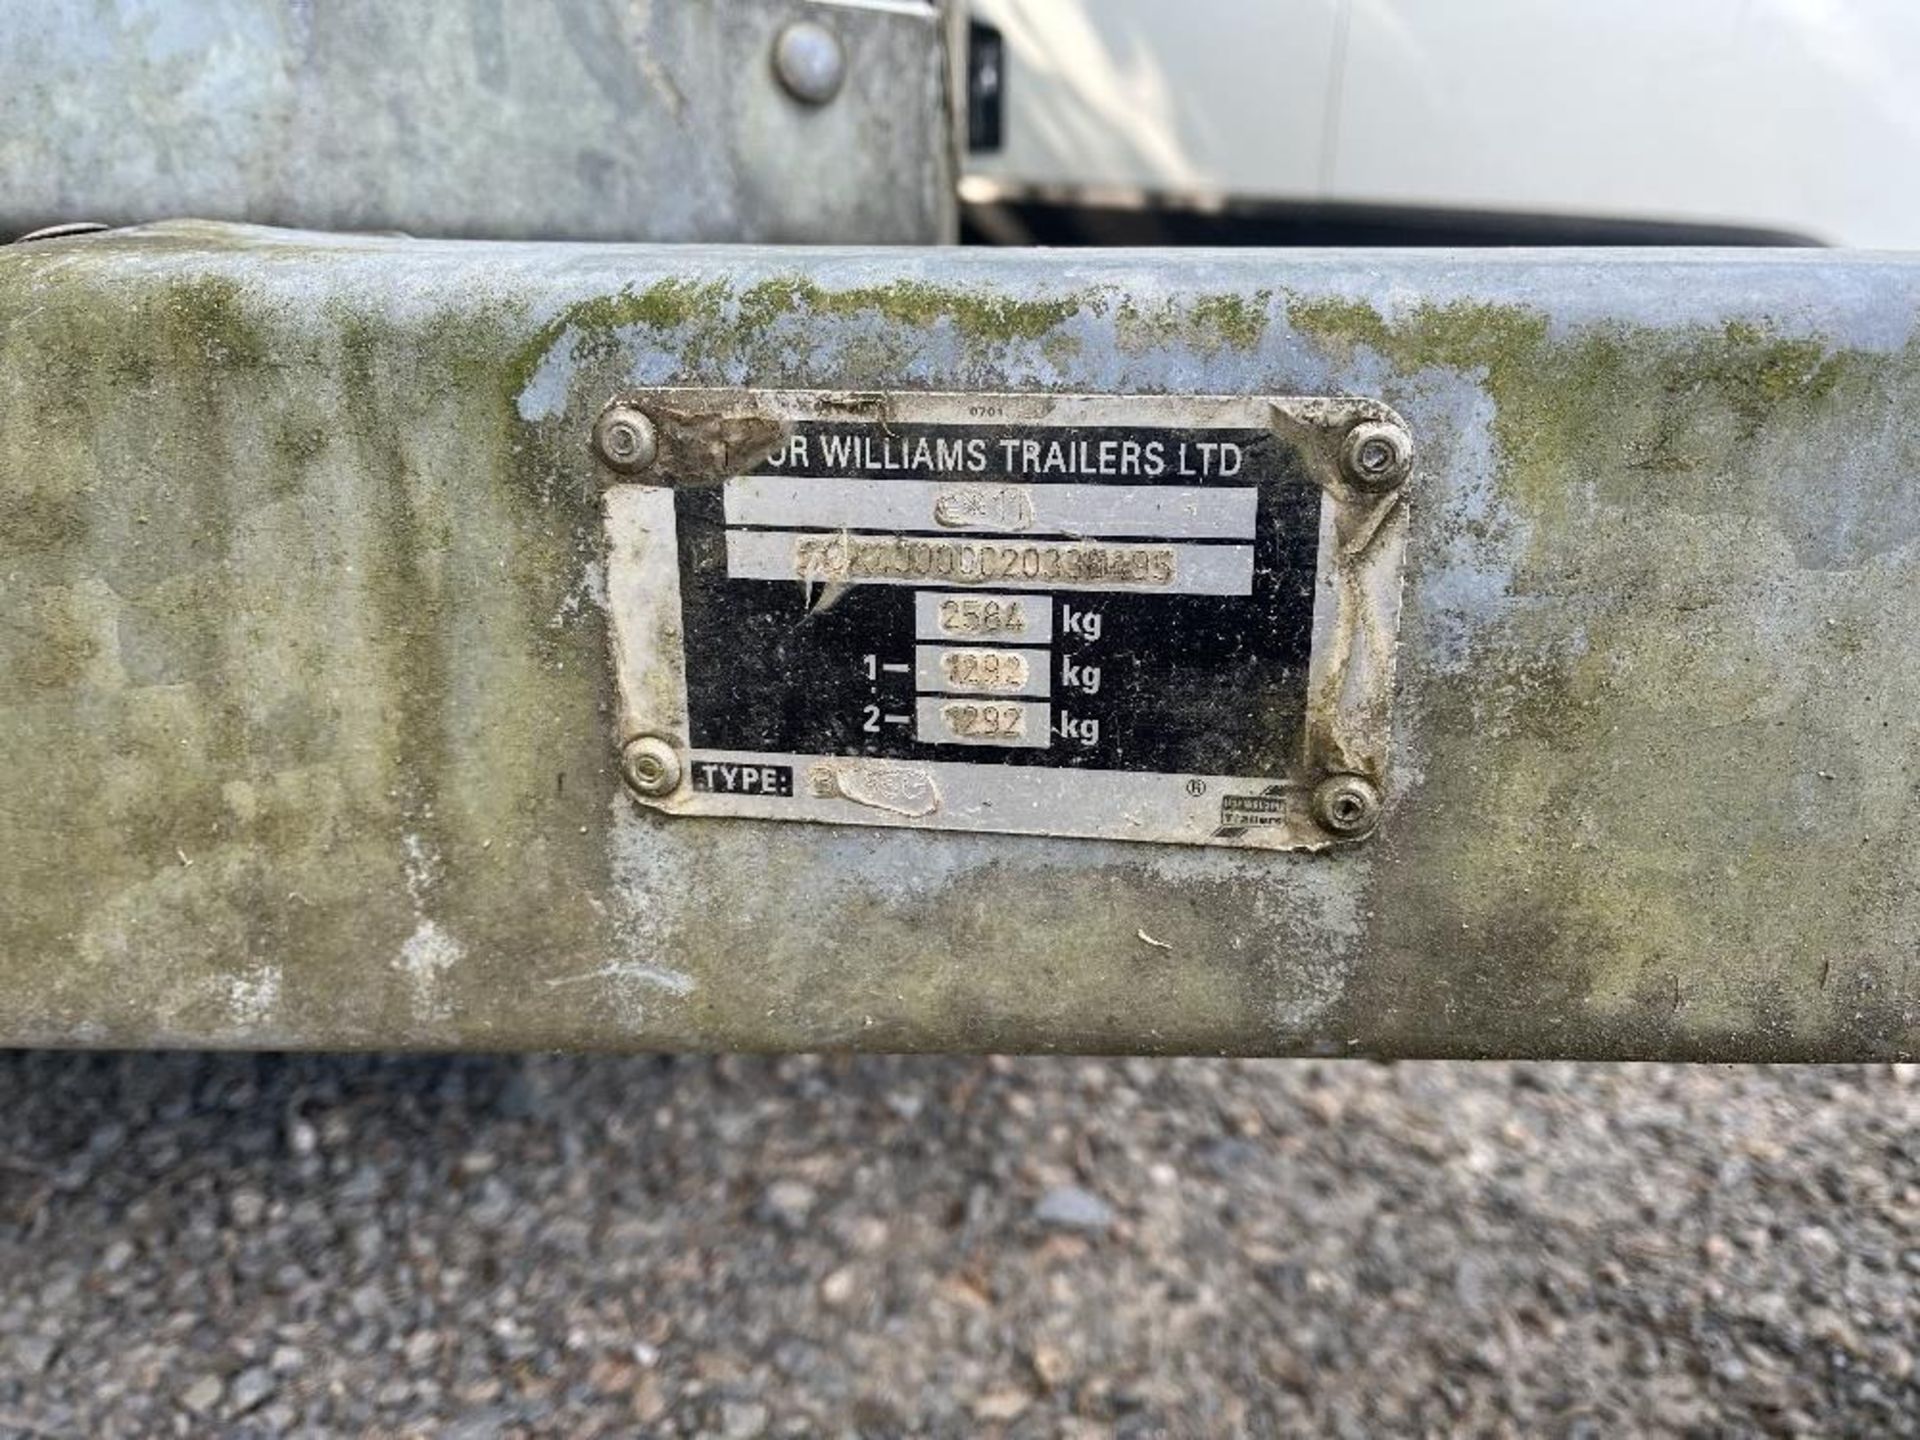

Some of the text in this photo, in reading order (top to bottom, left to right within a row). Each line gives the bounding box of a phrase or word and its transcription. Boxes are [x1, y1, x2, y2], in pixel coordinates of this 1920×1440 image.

[970, 406, 1003, 417] 0701
[821, 437, 988, 472] WILLIAMS
[1000, 440, 1166, 476] TRAILERS
[1179, 443, 1243, 477] LTD
[941, 599, 1102, 641] 2584 kg
[944, 653, 1022, 685] 1292
[1061, 658, 1102, 694] kg
[1060, 710, 1101, 746] kg
[701, 764, 788, 794] TYPE:
